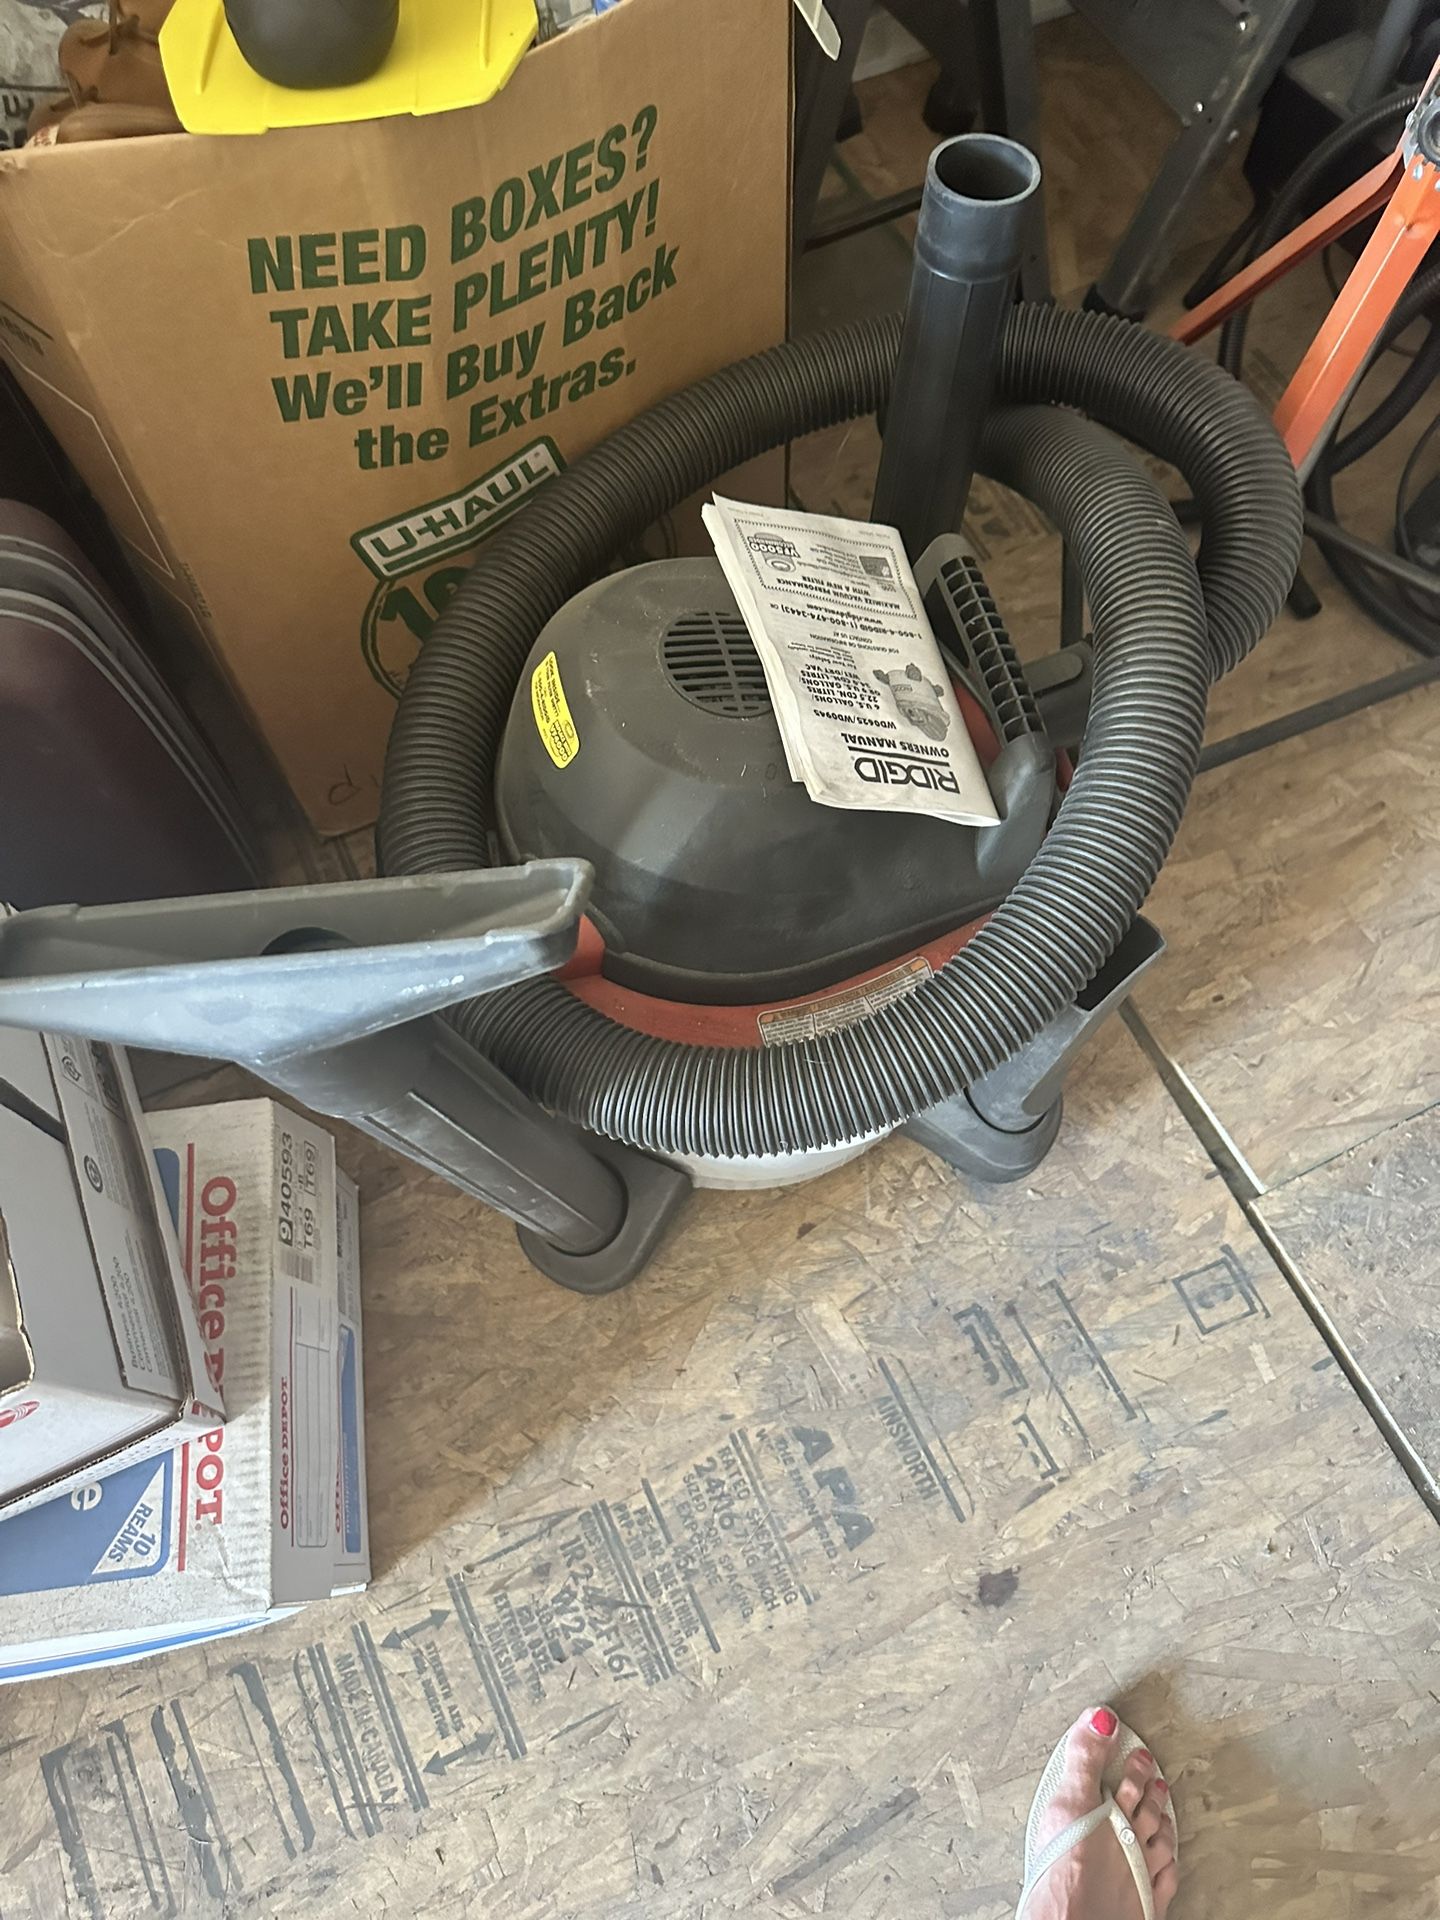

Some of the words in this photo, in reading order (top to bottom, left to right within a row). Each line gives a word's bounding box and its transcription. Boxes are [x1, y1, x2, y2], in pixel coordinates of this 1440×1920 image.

[247, 224, 427, 294] NEED
[451, 104, 658, 265] BOXES?
[269, 294, 432, 359] TAKE
[453, 178, 660, 333] PLENTY!
[272, 361, 422, 423] We'll
[447, 321, 546, 400] Buy
[563, 243, 681, 346] Back
[354, 425, 449, 470] the
[469, 346, 637, 448] Extras.
[370, 459, 549, 558] U-HAUL
[776, 577, 829, 594] PERFORMANCE
[802, 575, 824, 586] FILTER
[825, 580, 842, 589] NEW
[832, 589, 862, 602] VACUUM
[851, 586, 870, 596] WITH
[863, 596, 899, 610] MAXIMIZE
[801, 670, 829, 680] LITRES
[805, 663, 822, 672] VAC
[807, 686, 834, 696] LITRES
[841, 732, 895, 750] MANUAL
[900, 741, 949, 757] OWNERS
[854, 756, 960, 794] RIDGID
[199, 1177, 238, 1340] Office
[873, 1391, 939, 1501] AINSWORTH
[280, 1453, 289, 1529] Office
[790, 1427, 876, 1552] APA
[108, 1503, 153, 1563] REAMS
[132, 1533, 158, 1557] 10
[675, 1500, 722, 1587] EXPOSURE
[681, 1472, 708, 1514] SIZED
[702, 1518, 724, 1549] FOR
[718, 1554, 756, 1619] SPACING
[717, 1446, 752, 1502] RATED
[745, 1507, 799, 1606] SHEATHING
[751, 1569, 781, 1612] INCH
[334, 1652, 367, 1704] MADE
[352, 1704, 374, 1726] IN
[446, 1703, 466, 1733] AXIS
[359, 1727, 400, 1803] CANADA
